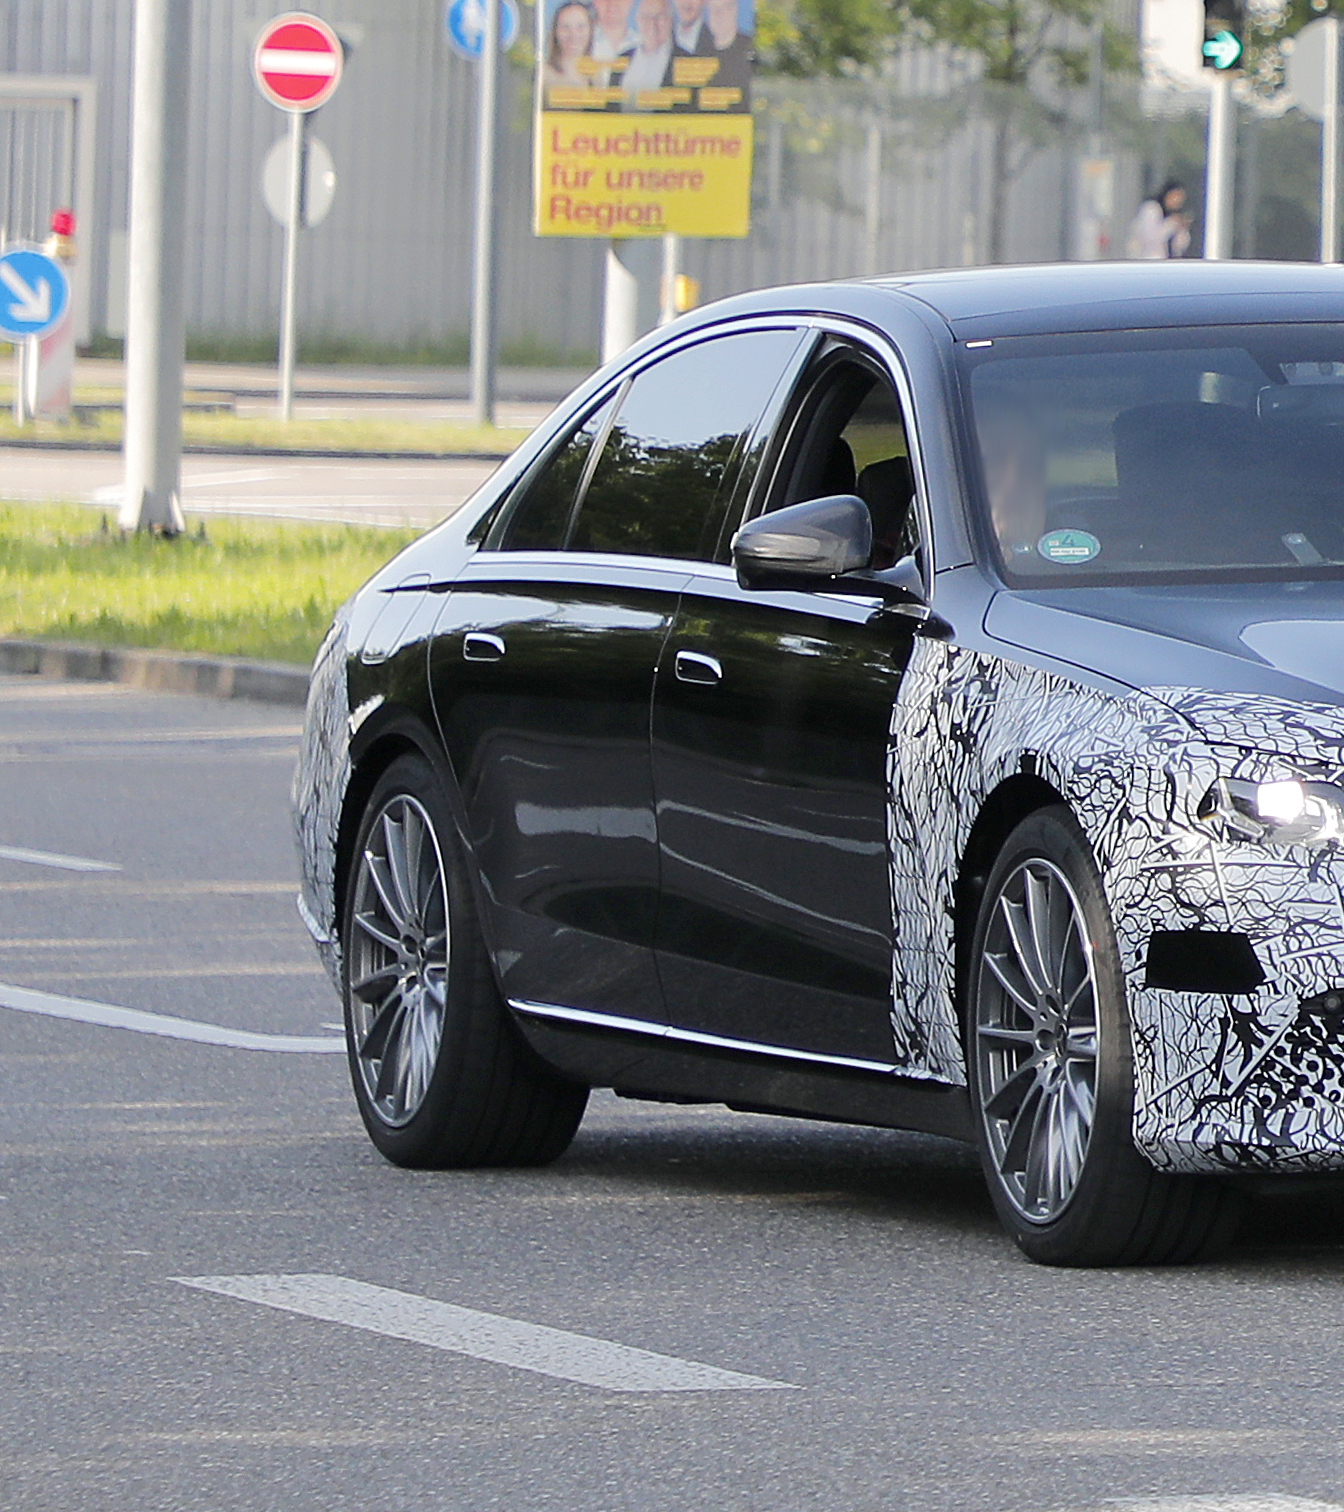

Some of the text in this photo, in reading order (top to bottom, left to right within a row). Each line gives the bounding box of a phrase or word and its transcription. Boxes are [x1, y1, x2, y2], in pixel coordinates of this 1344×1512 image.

[551, 127, 742, 157] Leuchttürme
[551, 163, 704, 191] für unsere
[550, 194, 663, 232] Region
